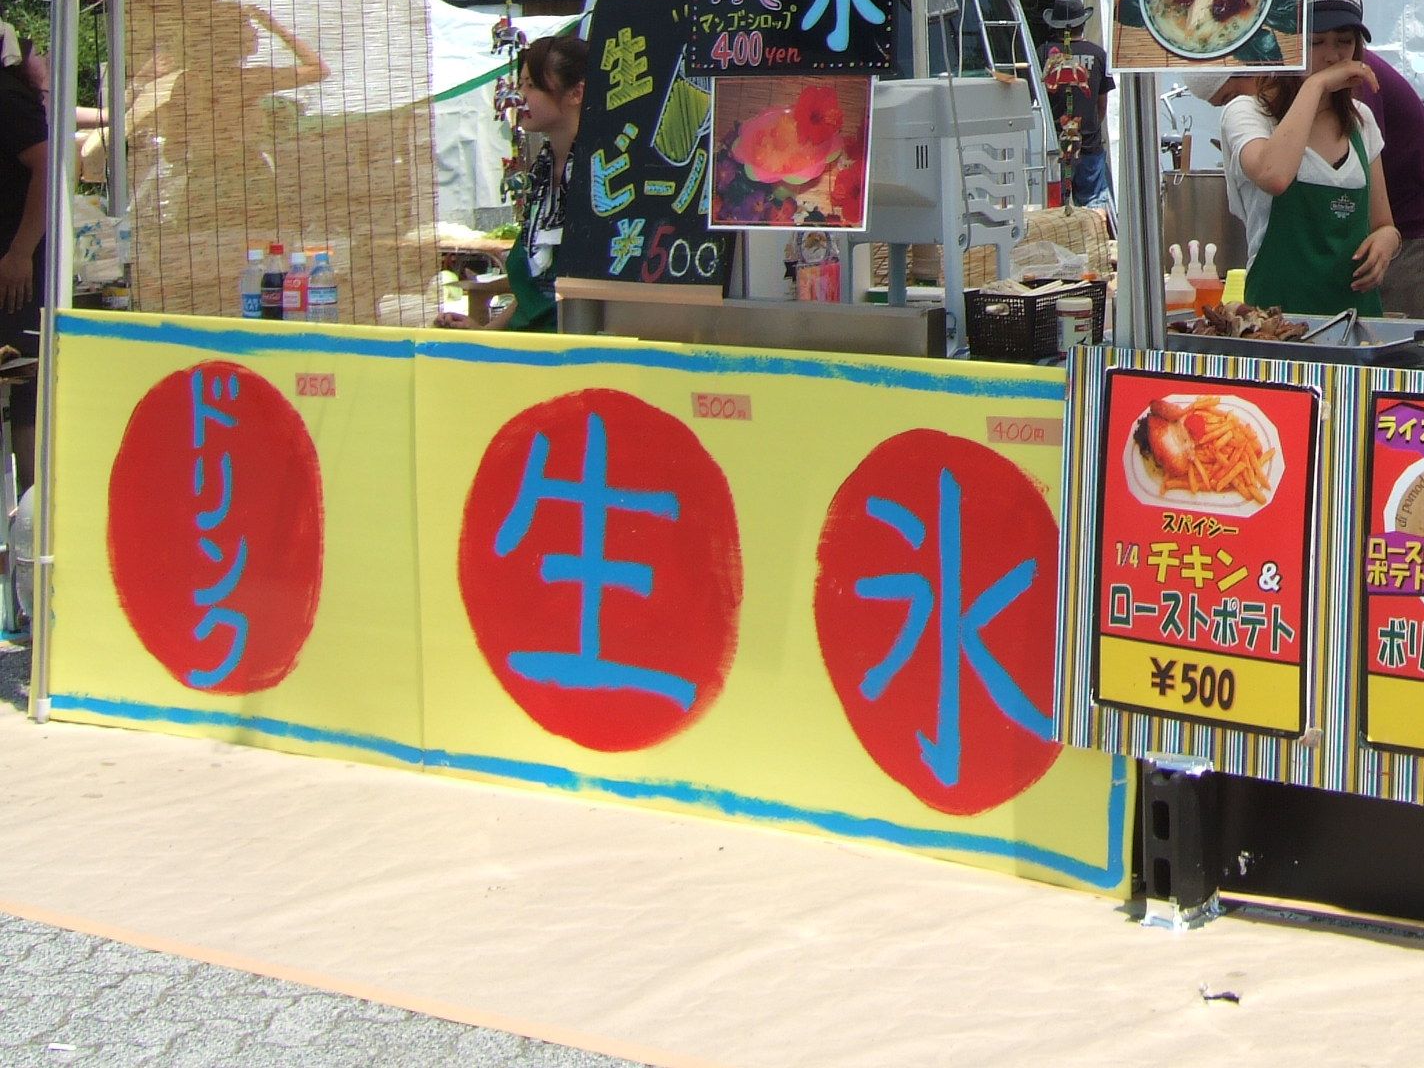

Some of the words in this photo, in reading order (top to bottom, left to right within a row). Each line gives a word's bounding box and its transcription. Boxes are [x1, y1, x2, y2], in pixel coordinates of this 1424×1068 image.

[600, 27, 653, 111] 生
[187, 369, 249, 689] ドリンク
[495, 412, 697, 712] 生
[1162, 512, 1239, 538] スパイシー
[1115, 541, 1140, 569] 1/4
[1147, 542, 1249, 592] チキン
[1257, 562, 1282, 592] &
[854, 466, 1054, 789] 氷
[1108, 583, 1295, 654] ローストポテト
[1149, 657, 1235, 711] ¥500
